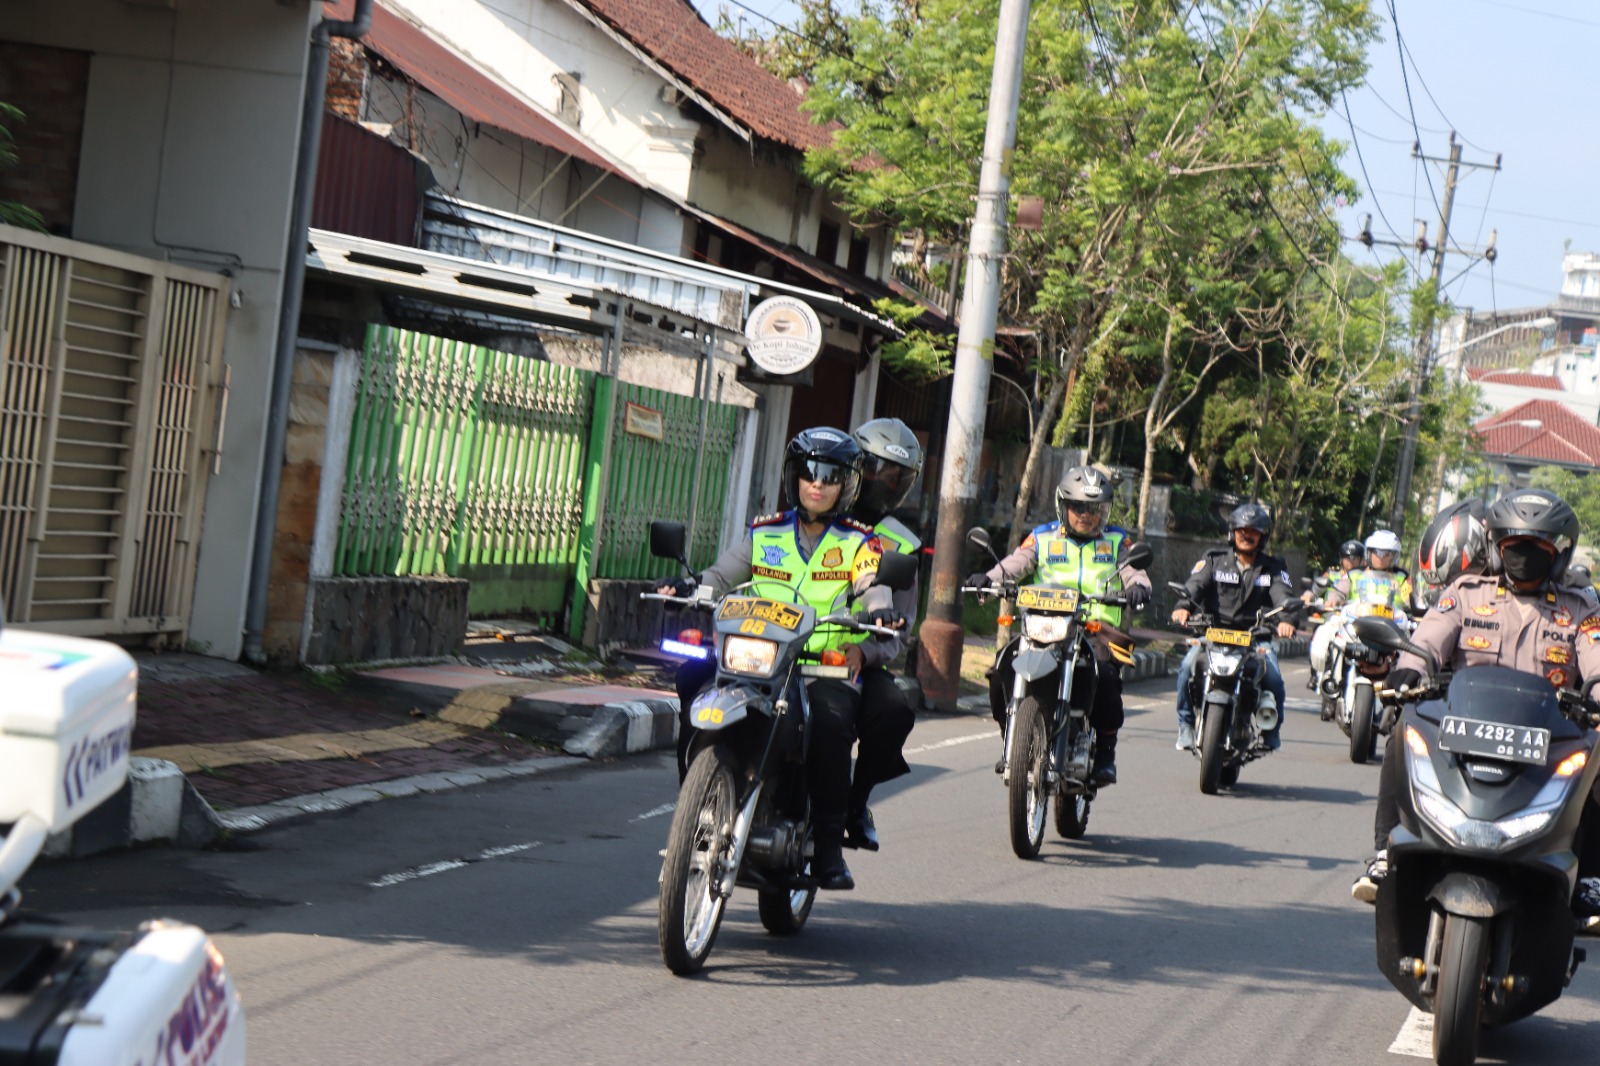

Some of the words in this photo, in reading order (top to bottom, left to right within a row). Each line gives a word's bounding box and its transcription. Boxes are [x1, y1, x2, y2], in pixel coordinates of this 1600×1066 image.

[763, 341, 783, 350] Kopi
[856, 556, 880, 572] KAO
[757, 566, 788, 580] YOLANDA
[815, 571, 849, 580] KAPOLRES
[740, 618, 767, 635] 05
[698, 708, 724, 724] 05
[1445, 720, 1467, 736] AA
[1475, 724, 1515, 742] 4292
[1522, 731, 1544, 747] AA
[1473, 765, 1503, 775] HONDA
